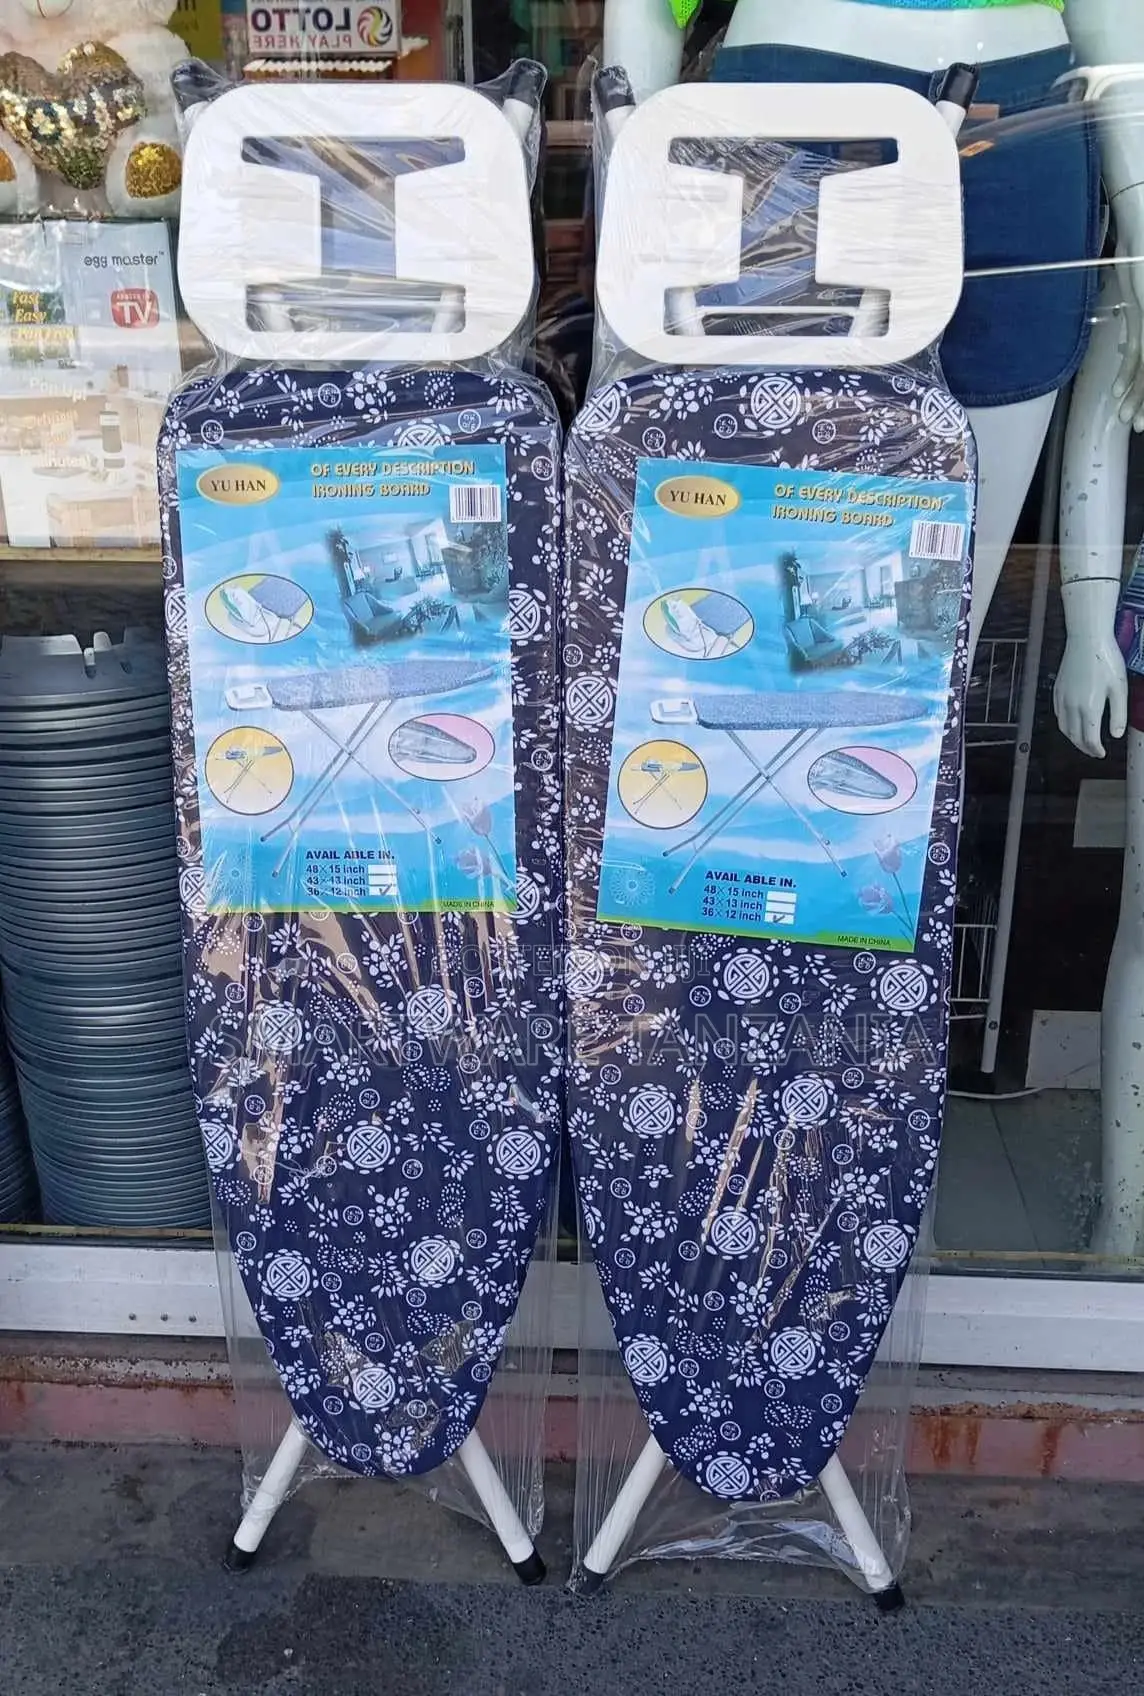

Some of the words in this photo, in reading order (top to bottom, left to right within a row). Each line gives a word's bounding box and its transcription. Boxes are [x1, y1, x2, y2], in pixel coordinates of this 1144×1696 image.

[84, 255, 108, 268] egg
[15, 308, 47, 323] Easy
[116, 301, 152, 325] TV
[311, 463, 331, 477] OF
[335, 462, 377, 477] EVERY
[383, 460, 475, 476] DESCRIPTION
[211, 479, 231, 492] YU
[235, 479, 267, 492] HAN
[312, 484, 375, 498] IRONING
[380, 483, 431, 497] BOARD
[669, 489, 691, 504] YU
[694, 491, 727, 506] HAN
[774, 484, 795, 497] OF
[799, 486, 844, 502] EVERY
[848, 488, 944, 511] DESCRIPTION
[772, 505, 837, 522] IRONING
[841, 509, 895, 527] BOARD
[305, 850, 340, 860] AVAIL
[343, 850, 374, 860] ABLE
[343, 864, 365, 874] inch
[343, 875, 366, 885] inch
[705, 870, 741, 882] AVAIL
[744, 874, 777, 886] ABLE
[344, 887, 366, 896] inch
[741, 888, 764, 899] inch
[740, 899, 763, 911] inch
[739, 911, 761, 922] inch
[837, 935, 859, 944] MADE
[868, 938, 891, 946] CHINA
